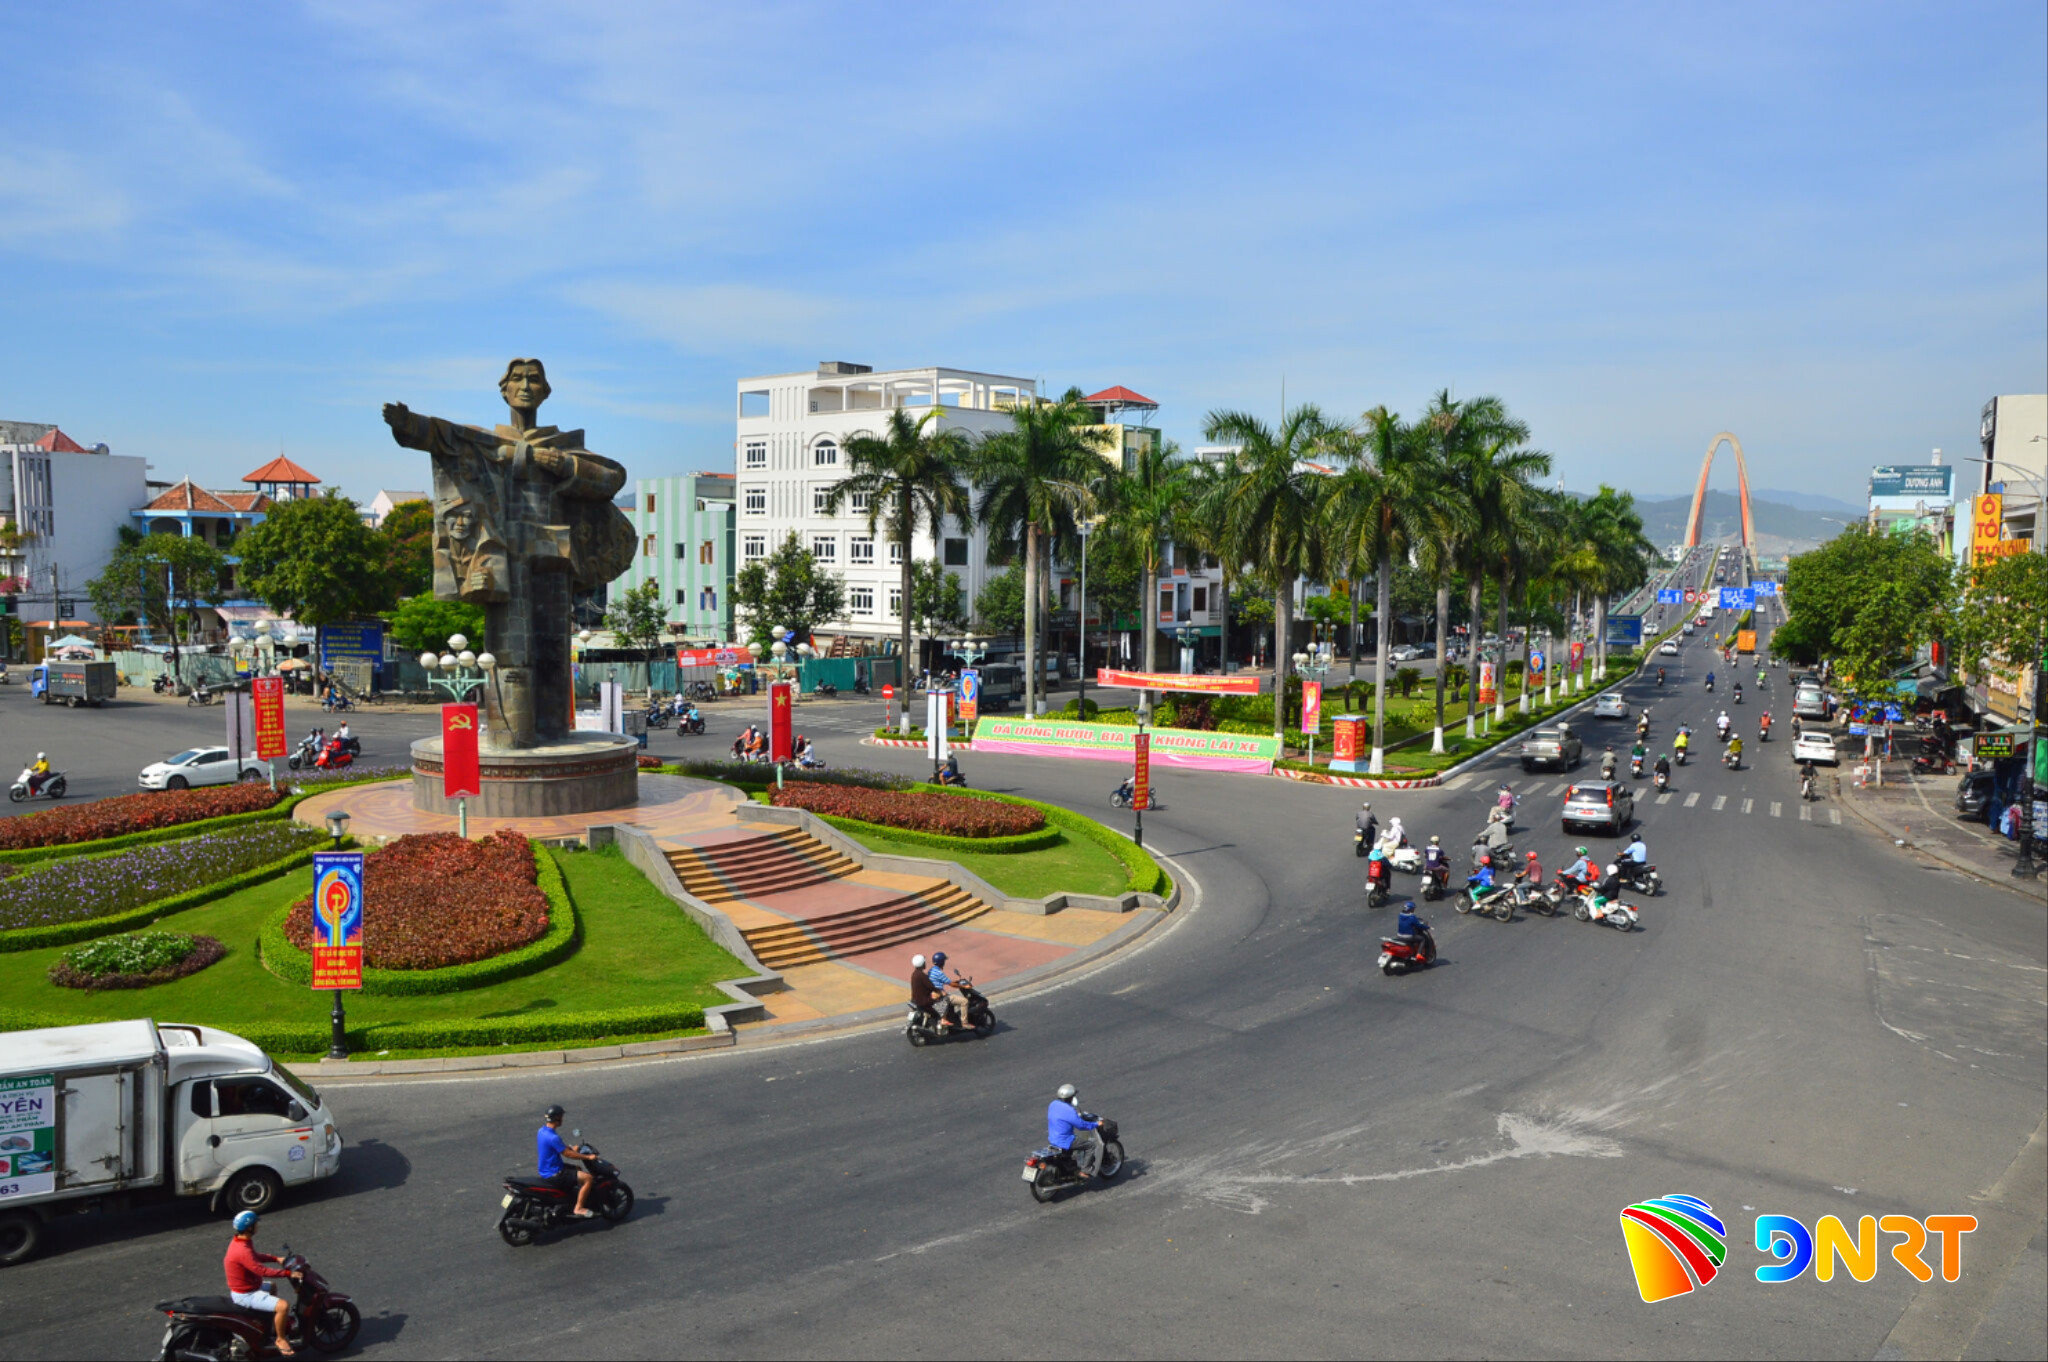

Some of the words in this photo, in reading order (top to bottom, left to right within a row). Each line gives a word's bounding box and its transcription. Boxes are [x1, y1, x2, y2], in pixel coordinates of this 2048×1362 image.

[1982, 495, 1996, 515] Ô
[1976, 518, 1999, 538] TÔ
[1101, 731, 1124, 742] BIA
[1155, 734, 1206, 748] KHÔNG
[1210, 738, 1235, 750] LÁI
[1238, 742, 1259, 752] XE
